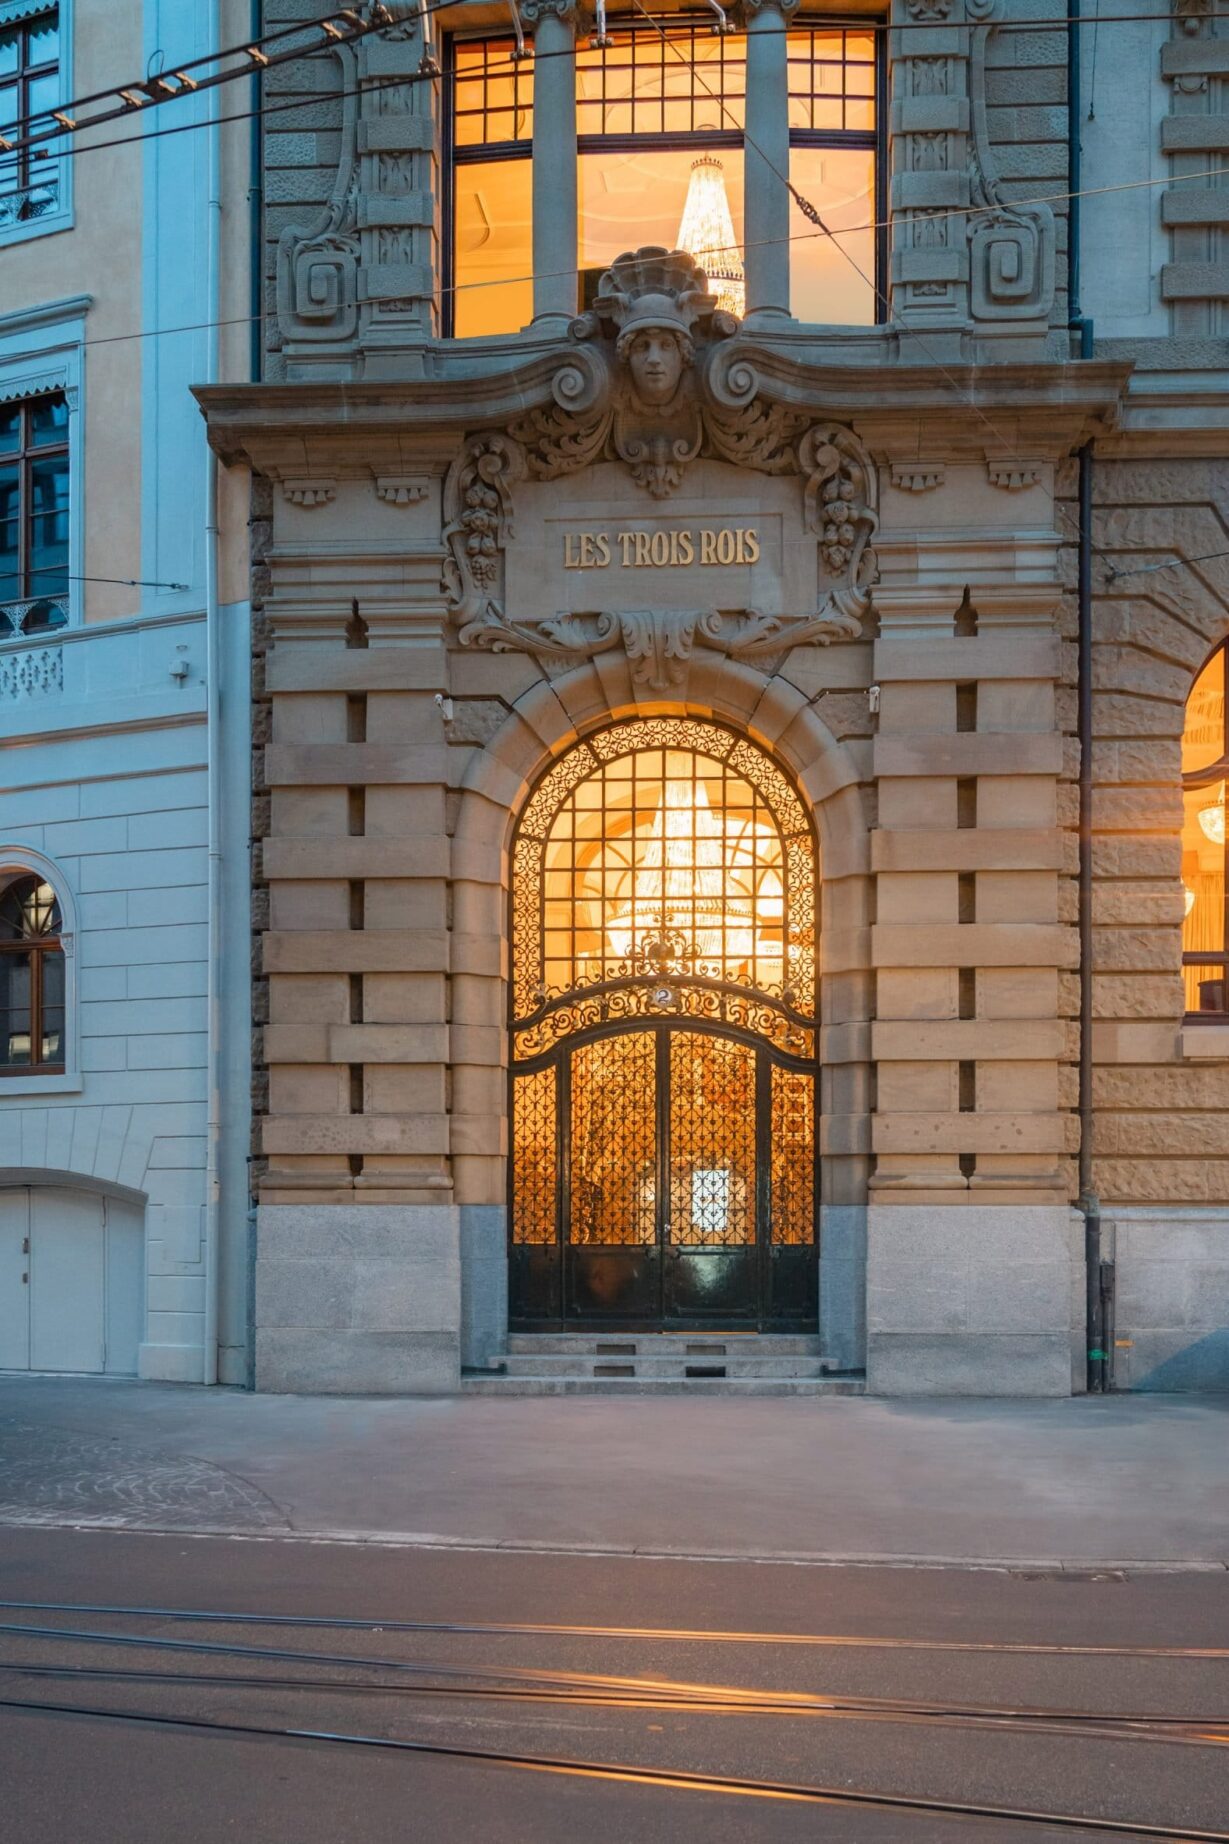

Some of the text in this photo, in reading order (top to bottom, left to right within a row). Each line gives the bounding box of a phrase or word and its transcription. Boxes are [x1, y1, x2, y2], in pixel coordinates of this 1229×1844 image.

[563, 528, 761, 568] LES TROIS ROIS
[658, 989, 669, 1003] 2
